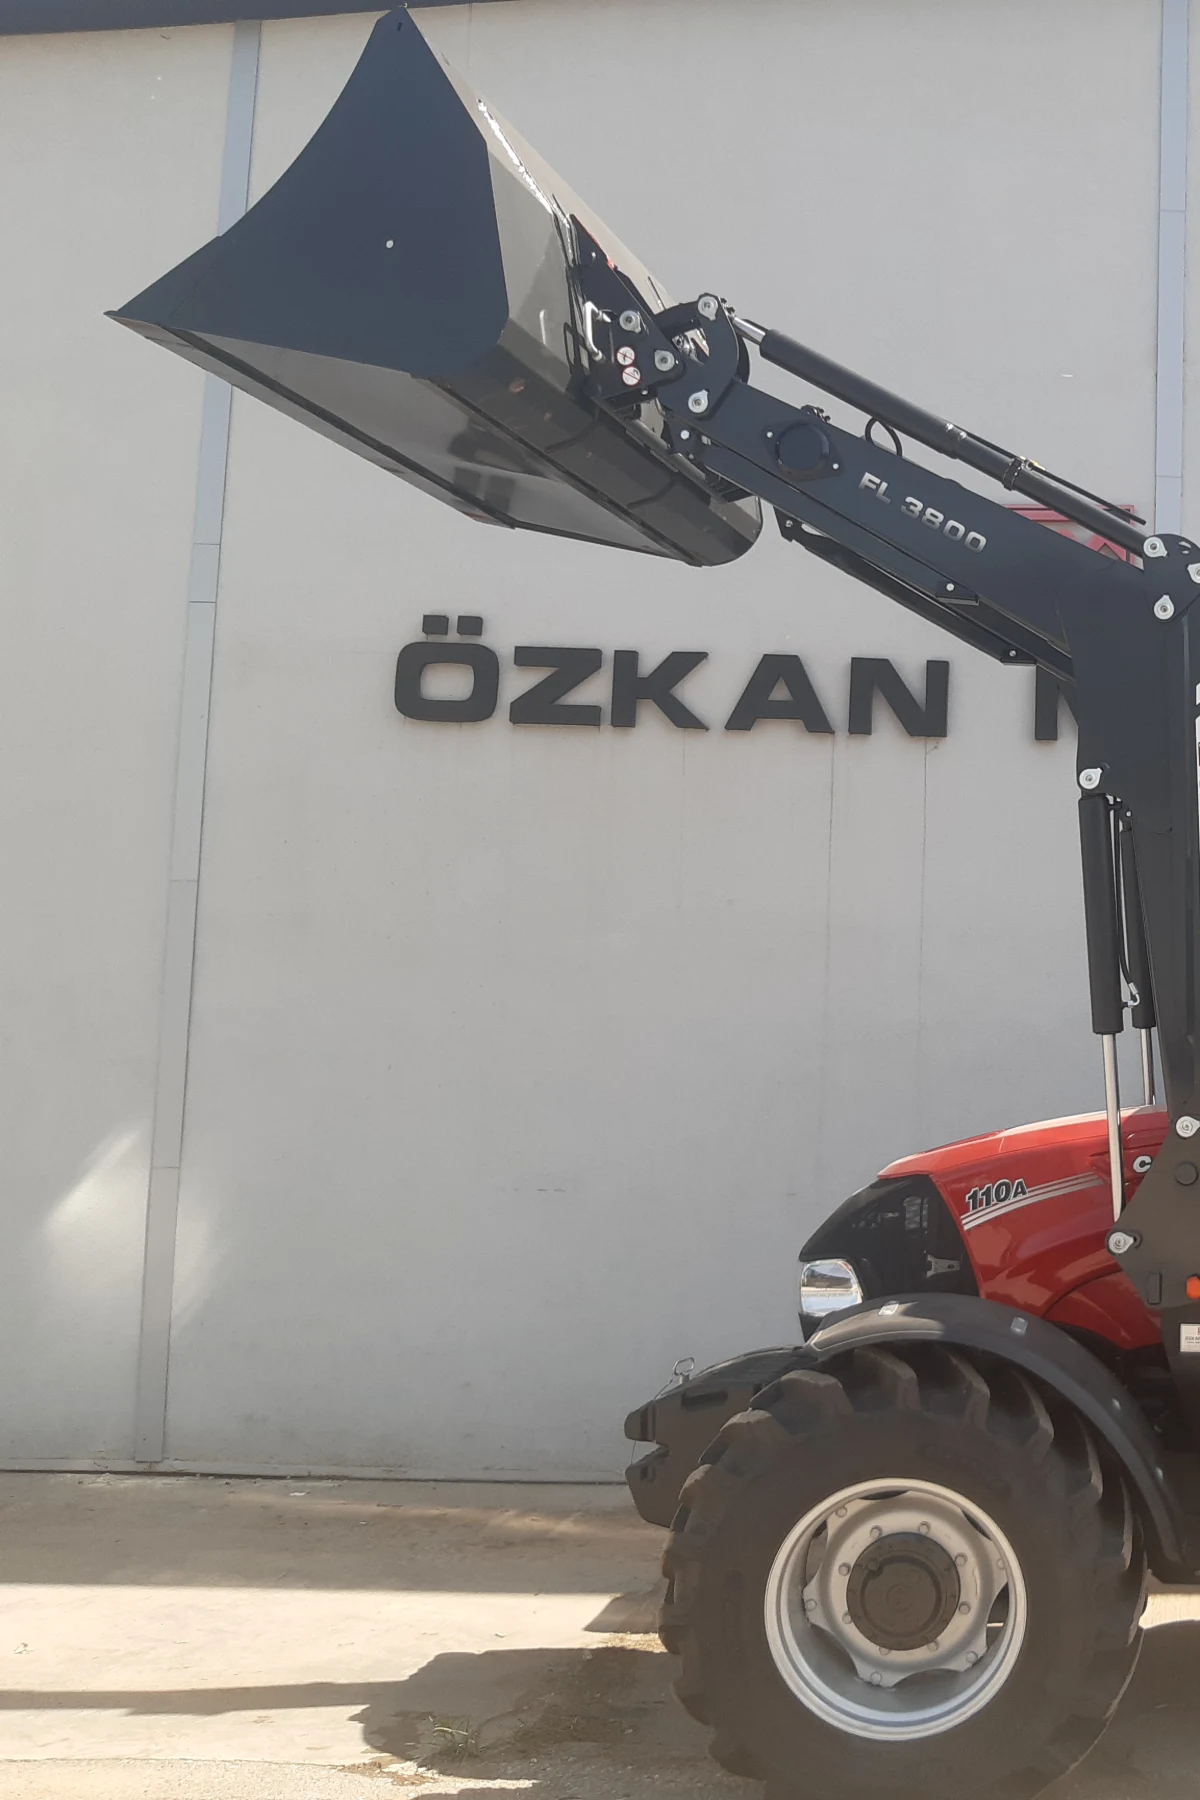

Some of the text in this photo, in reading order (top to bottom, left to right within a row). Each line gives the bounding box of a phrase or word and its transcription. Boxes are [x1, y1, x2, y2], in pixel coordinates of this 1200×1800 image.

[858, 472, 987, 554] FL 3800
[394, 614, 950, 738] ÖZKAN
[965, 1178, 1028, 1212] 110A
